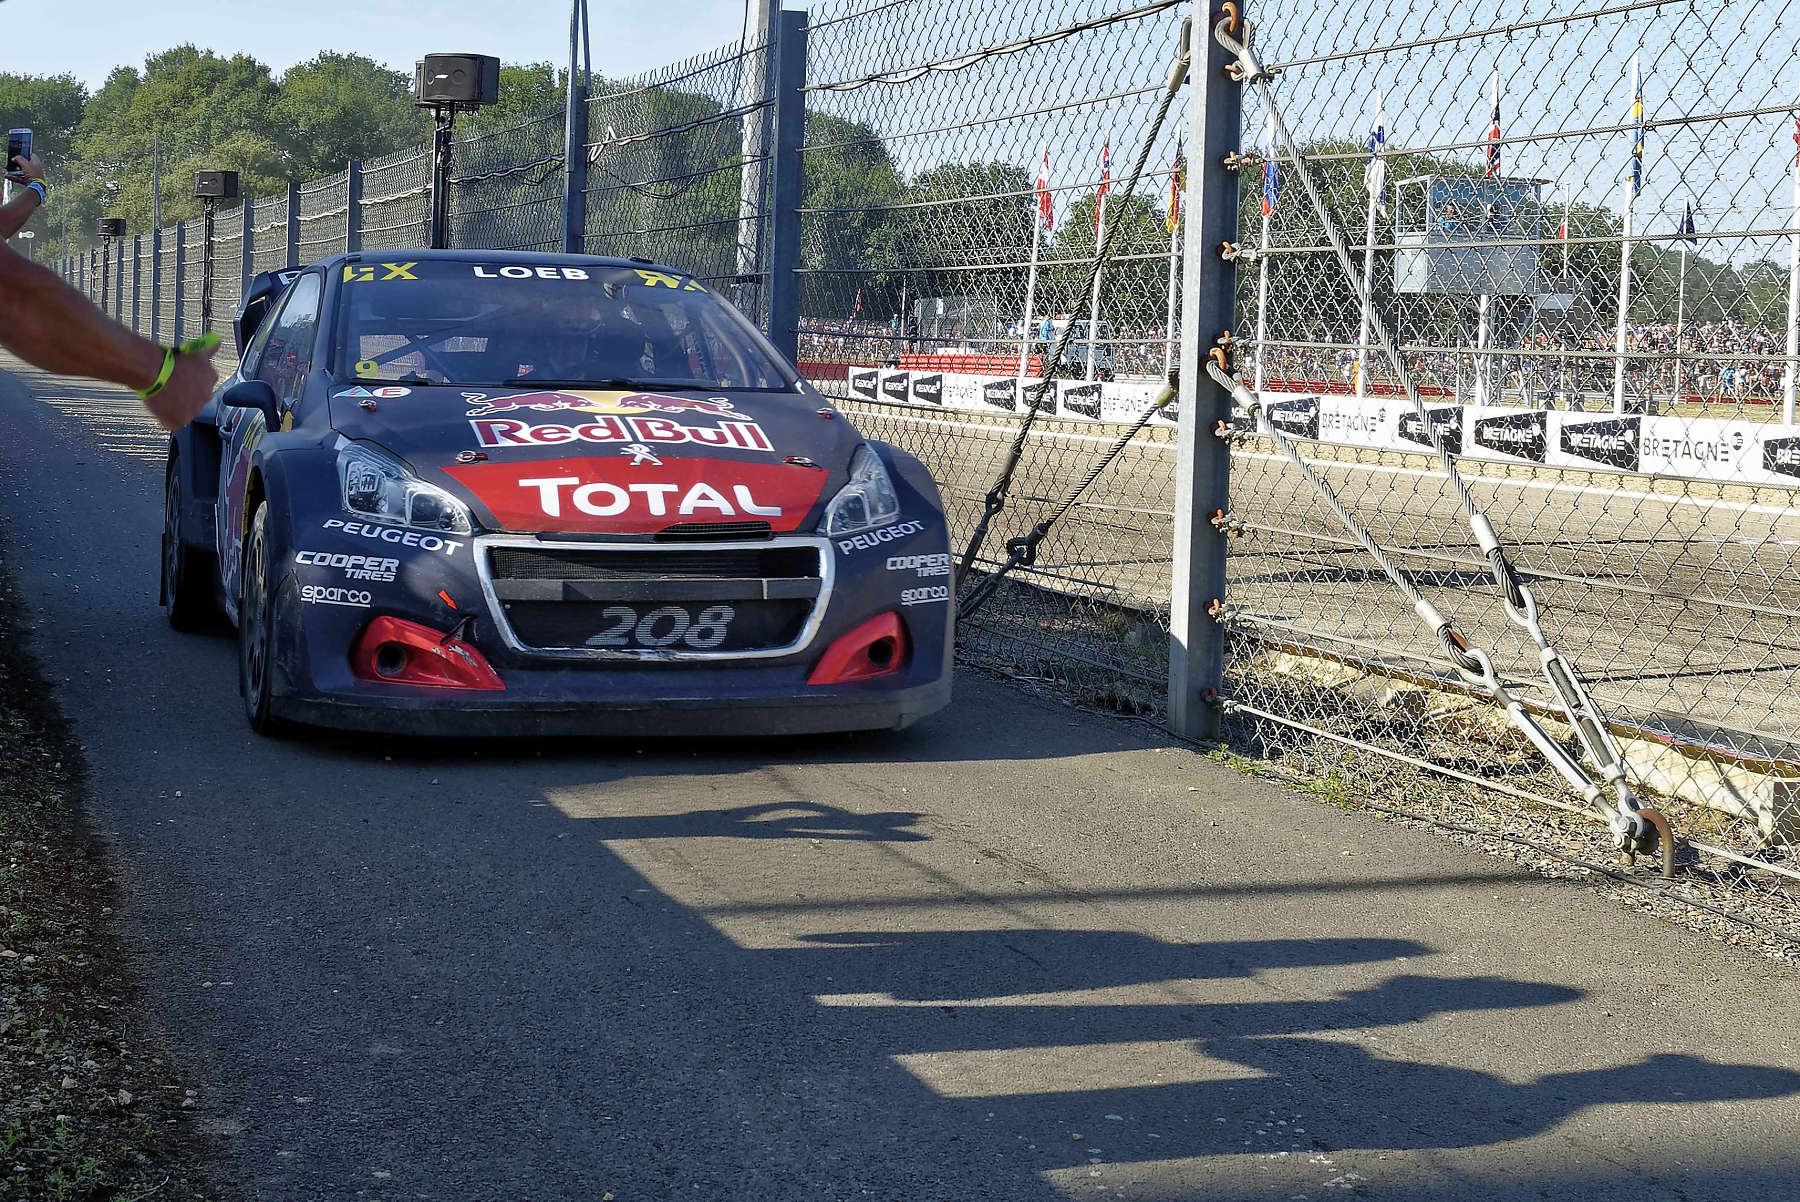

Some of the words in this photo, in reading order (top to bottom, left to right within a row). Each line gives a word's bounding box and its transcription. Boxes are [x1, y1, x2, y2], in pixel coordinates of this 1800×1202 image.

[473, 266, 590, 280] LOEB
[355, 360, 378, 379] 9
[470, 416, 631, 448] Red
[629, 417, 773, 451] Bull
[1570, 433, 1626, 450] BRETAGNE
[1643, 438, 1730, 462] BRETAGNE
[518, 477, 782, 517] TOTAL
[322, 519, 464, 555] PEUGEOT
[838, 520, 925, 555] PEUGEOT
[295, 551, 400, 572] COOPER
[886, 553, 950, 570] COOPER
[916, 565, 950, 577] TIRES
[344, 568, 397, 582] TIRES
[301, 585, 372, 606] sparco
[901, 586, 949, 606] sparco
[585, 605, 735, 648] 208
